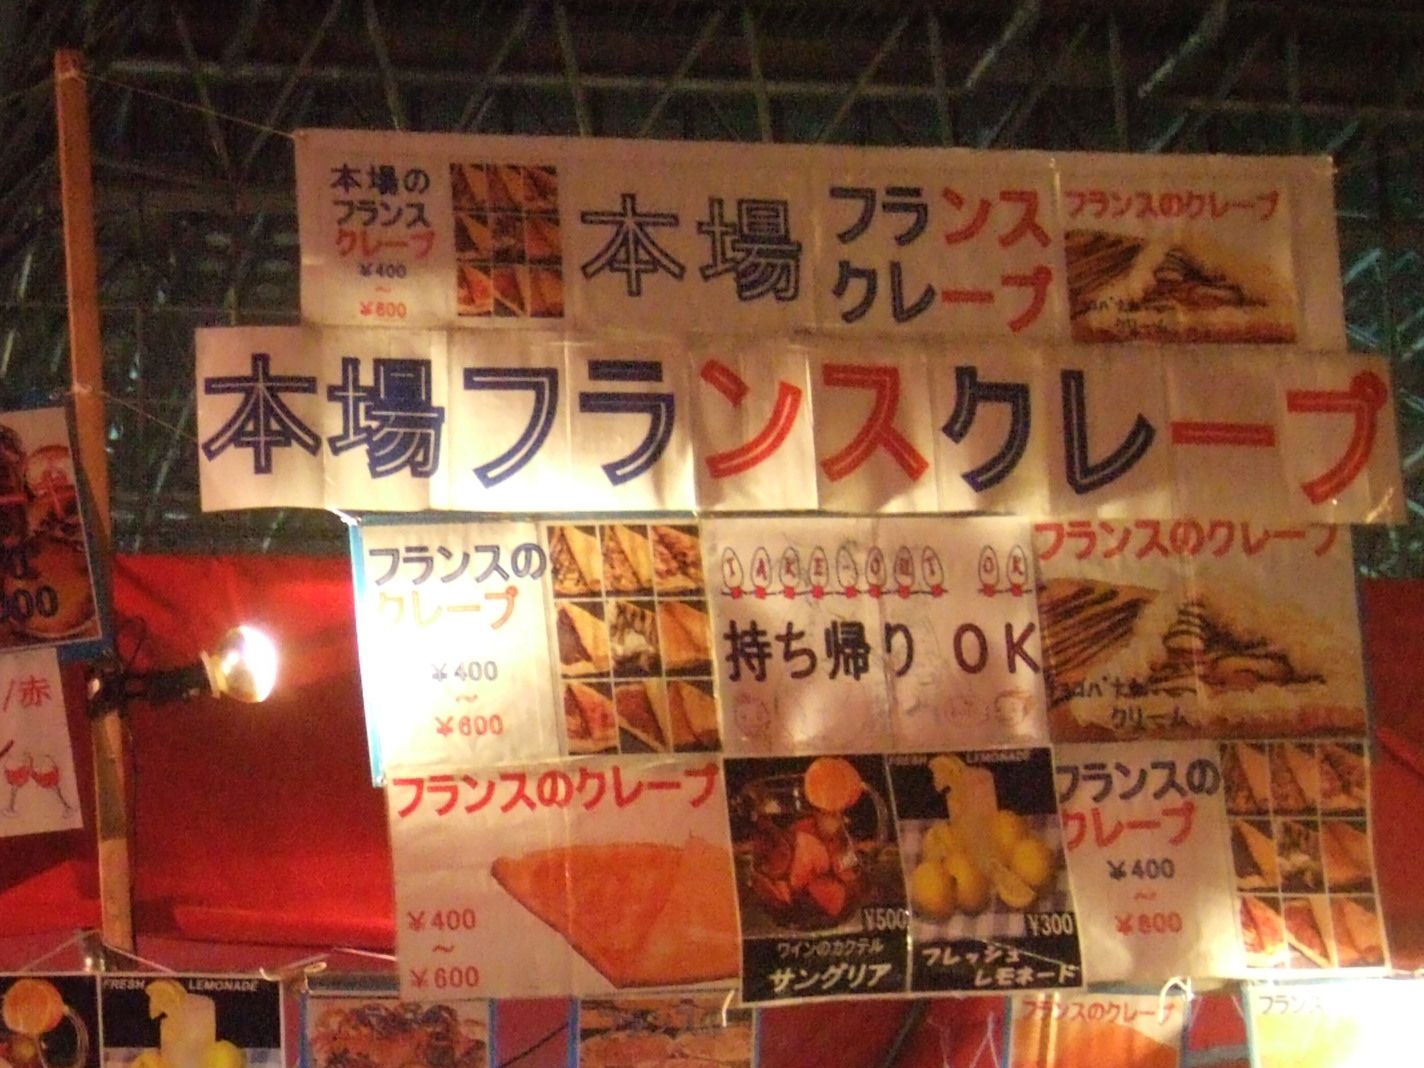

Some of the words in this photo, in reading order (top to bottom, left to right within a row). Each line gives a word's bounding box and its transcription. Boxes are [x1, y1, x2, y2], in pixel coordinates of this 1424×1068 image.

[330, 163, 431, 196] 本場の
[332, 199, 431, 229] フランス
[828, 185, 1052, 249] フランス
[1065, 189, 1281, 222] フランスのクレープ
[335, 227, 436, 260] クレープ
[579, 192, 804, 302] 本場
[831, 259, 1054, 333] クレープ
[201, 352, 1389, 506] 本場フランスクレープ
[368, 541, 548, 586] フランスの
[377, 584, 519, 630] クレープ
[722, 618, 915, 683] 持ち帰り
[952, 621, 1043, 675] OK
[431, 660, 499, 683] ¥400
[435, 714, 504, 738] ¥600
[392, 762, 720, 819] フランスのクレープ
[1107, 858, 1176, 880] ¥400
[407, 908, 477, 933] ¥400
[863, 908, 907, 931] ¥500
[1027, 913, 1074, 936] ¥300
[921, 944, 1021, 967] フレッシュ
[409, 966, 480, 991] ¥600
[768, 963, 892, 992] サングリア
[974, 963, 1080, 987] レモネード
